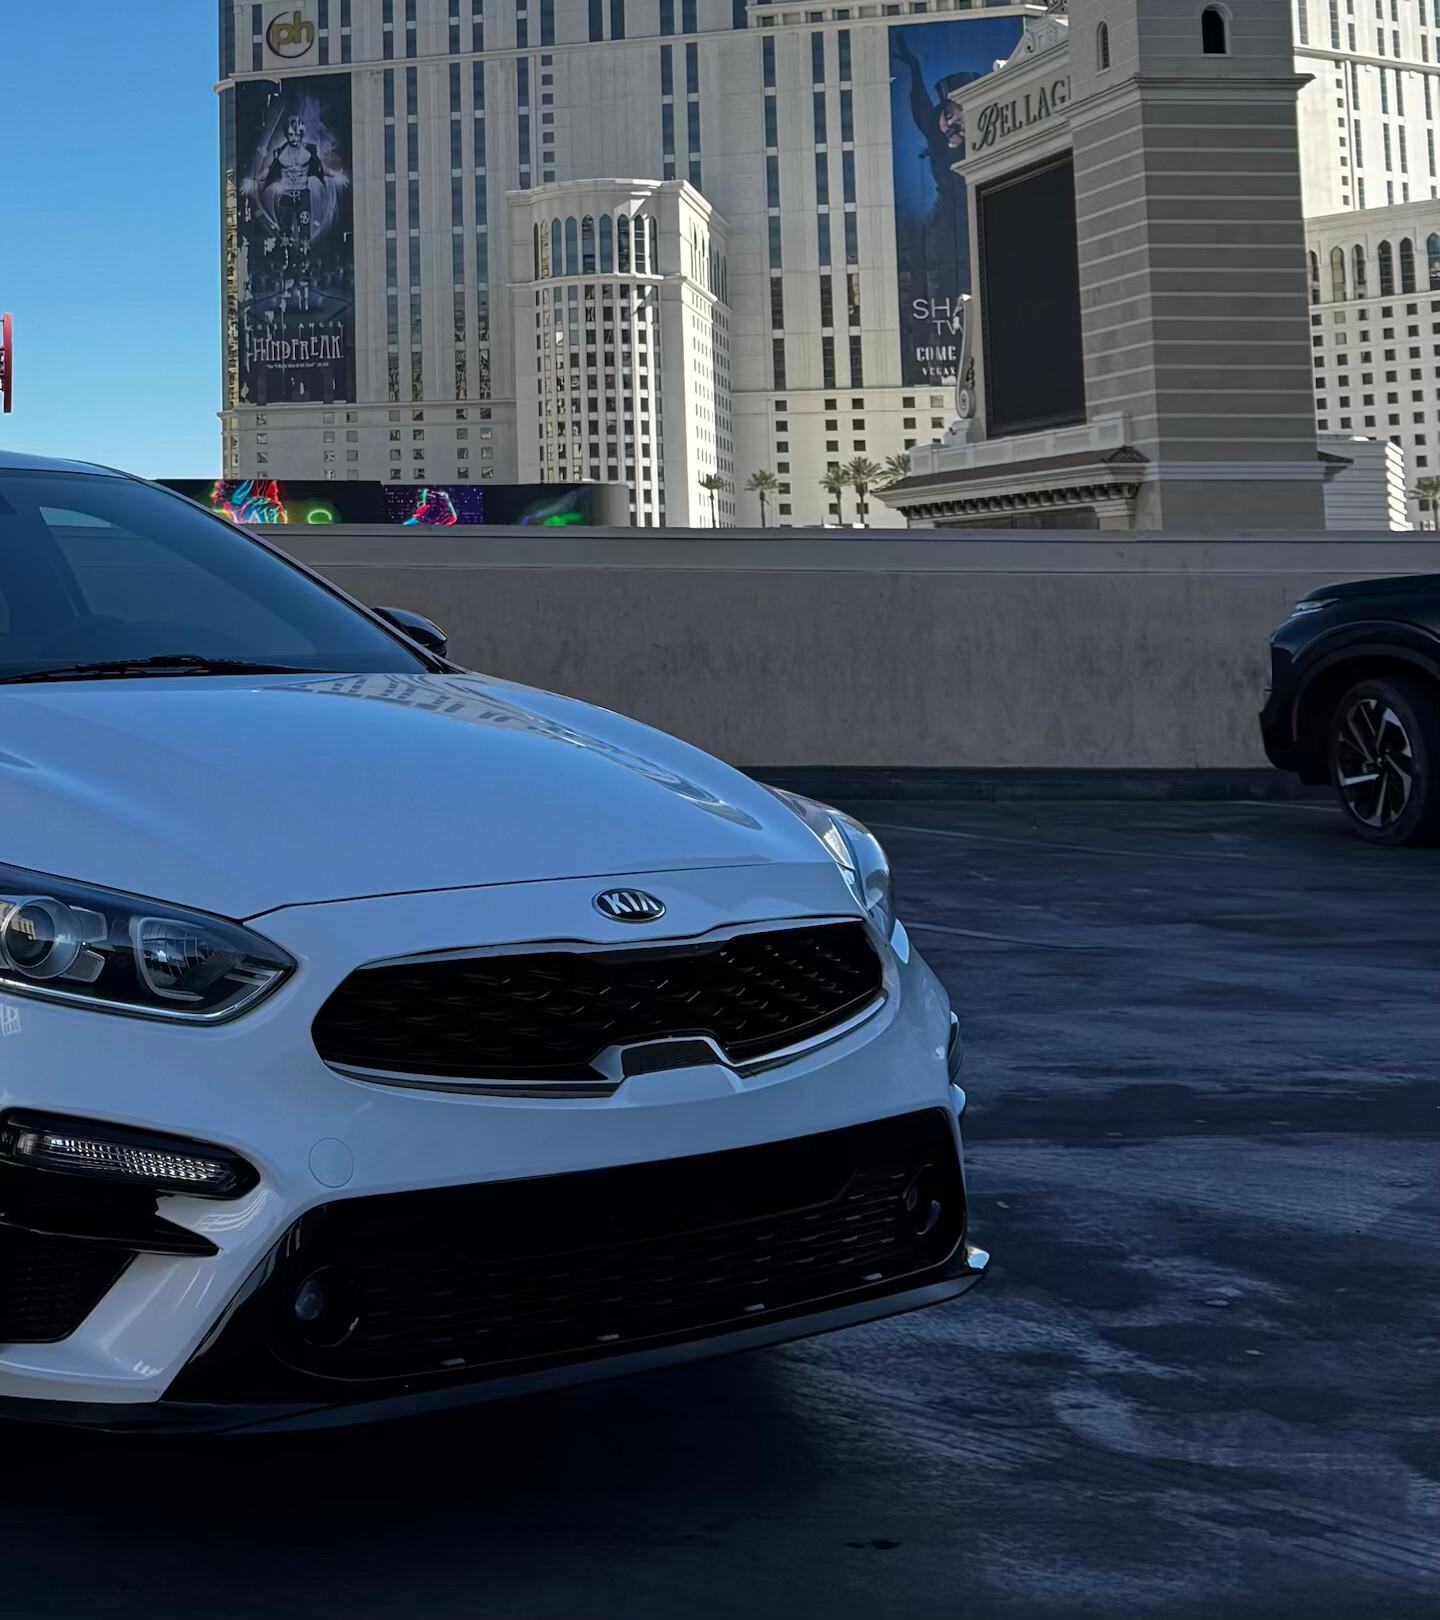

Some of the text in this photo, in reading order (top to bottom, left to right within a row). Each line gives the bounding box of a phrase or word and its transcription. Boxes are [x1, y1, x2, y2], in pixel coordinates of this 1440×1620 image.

[271, 10, 315, 50] ph
[916, 345, 957, 361] COME
[601, 891, 660, 915] KIA
